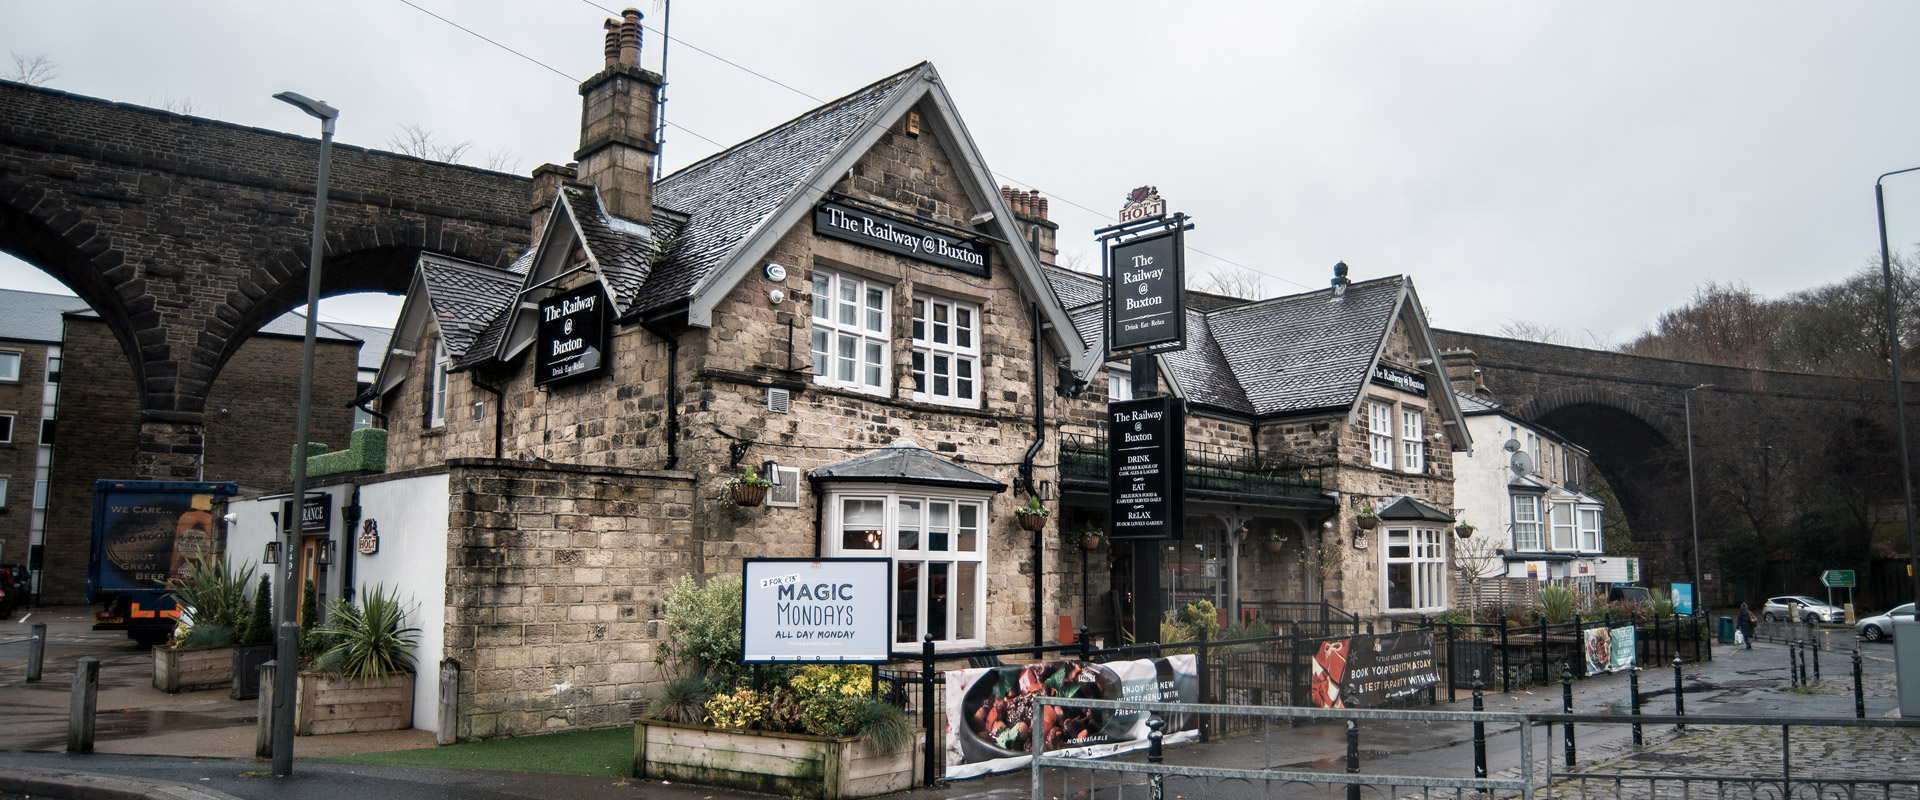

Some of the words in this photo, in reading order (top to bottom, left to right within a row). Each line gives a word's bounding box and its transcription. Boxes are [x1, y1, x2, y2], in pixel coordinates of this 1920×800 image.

[1121, 203, 1161, 222] HOLT
[827, 207, 859, 232] The
[862, 217, 921, 253] Railway
[922, 235, 936, 253] @
[937, 238, 984, 266] Buxton
[1132, 255, 1154, 268] The
[1123, 268, 1164, 285] Railway
[1138, 283, 1149, 295] @
[544, 305, 562, 322] The
[562, 295, 597, 317] Railway
[1125, 295, 1162, 311] Buxton
[564, 318, 574, 335] @
[1125, 323, 1139, 331] Drink
[1140, 321, 1149, 329] Eat
[1151, 319, 1165, 328] Relax
[553, 338, 583, 356] Buxton
[1383, 369, 1404, 387] Railway
[1408, 376, 1425, 391] Buxton
[1114, 412, 1131, 423] The
[1132, 410, 1163, 421] Railway
[1134, 421, 1143, 432] @
[1124, 432, 1153, 443] Buxton
[1127, 454, 1150, 464] DRINK
[1132, 483, 1146, 492] EAT
[302, 506, 324, 521] RANCE
[139, 530, 176, 542] HOOTS
[359, 539, 376, 549] HOLT
[769, 577, 783, 586] FOR
[778, 583, 854, 601] MAGIC
[775, 631, 793, 640] ALL
[796, 630, 815, 640] DAY
[817, 630, 856, 640] MONDAY
[1351, 666, 1369, 679] BOOK
[1388, 661, 1420, 675] CHRISTMAS
[1419, 659, 1432, 669] DAY
[1122, 684, 1146, 694] ENJOY
[1145, 682, 1159, 691] OUR
[1159, 680, 1175, 690] NEW
[1389, 677, 1408, 690] PARTY
[1408, 674, 1426, 685] WITH
[1426, 672, 1435, 681] US
[1142, 692, 1162, 702] MENU
[1162, 690, 1179, 699] WITH
